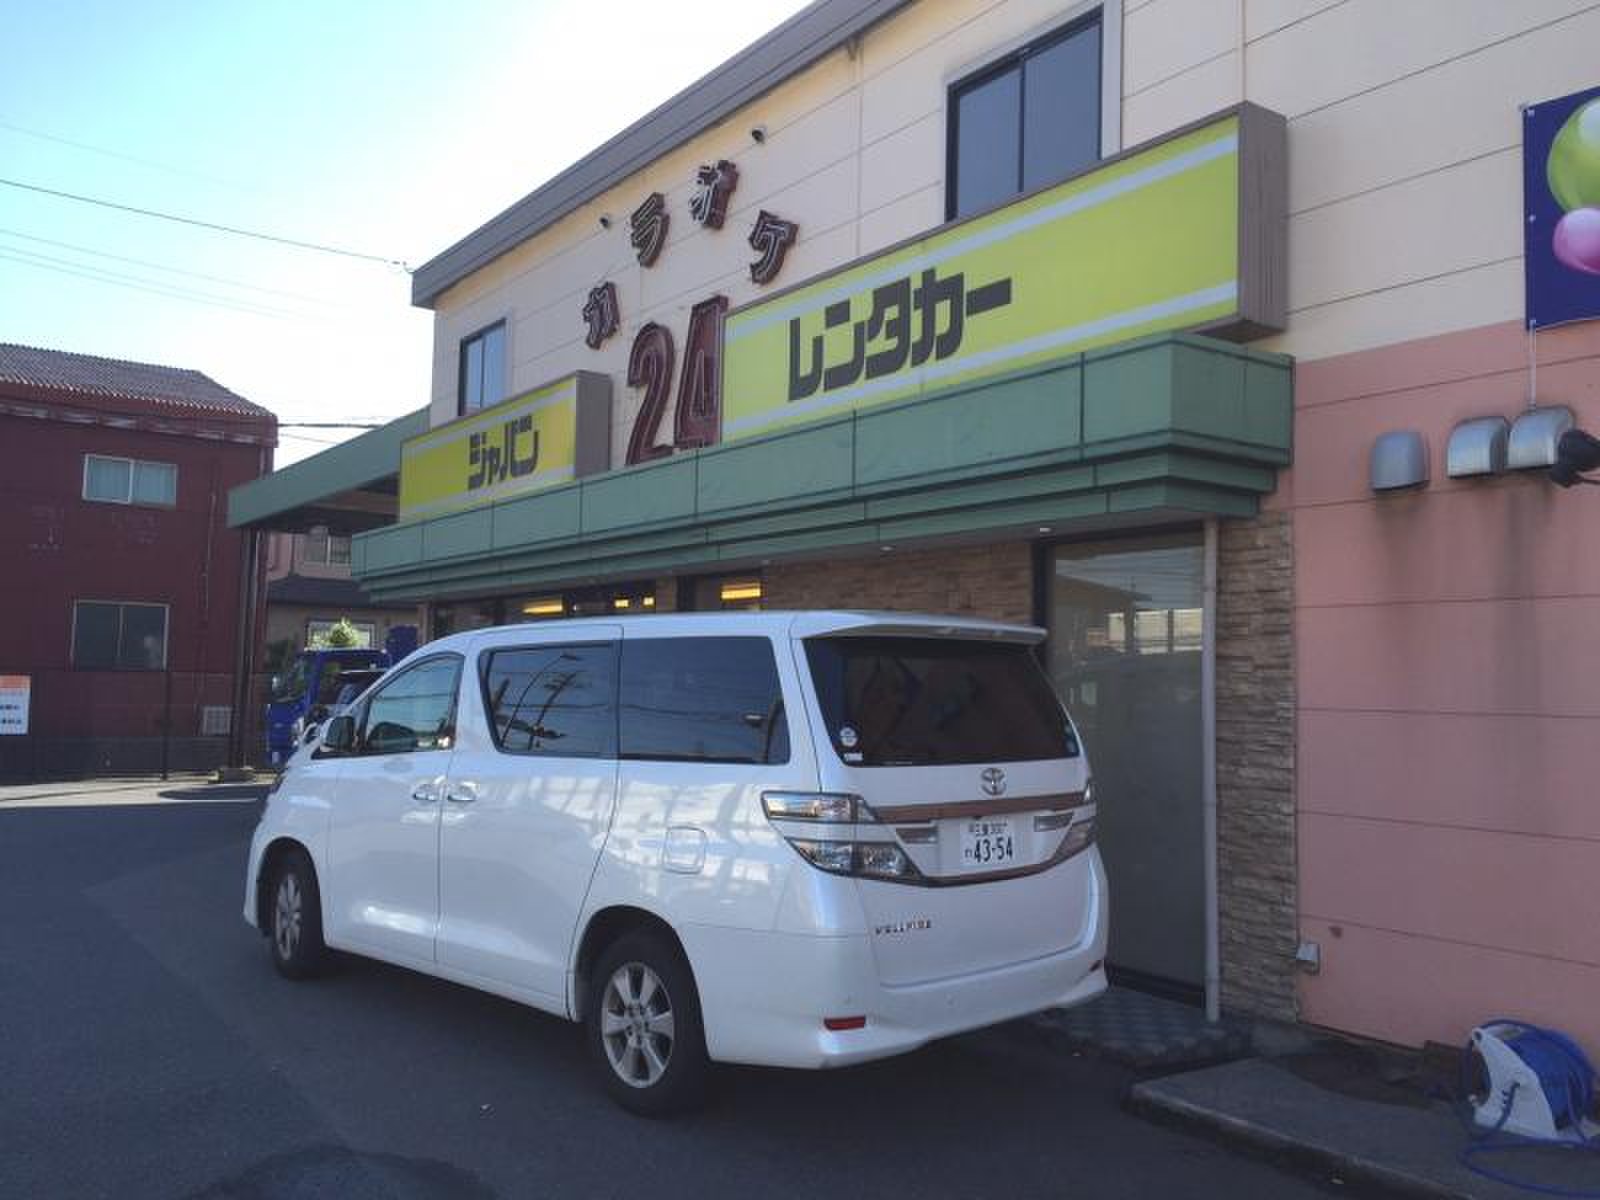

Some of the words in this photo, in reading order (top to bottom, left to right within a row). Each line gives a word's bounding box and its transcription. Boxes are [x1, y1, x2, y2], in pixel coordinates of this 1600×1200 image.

[625, 294, 729, 466] 24
[787, 266, 1012, 401] レンタカー
[974, 836, 1013, 863] 43-54
